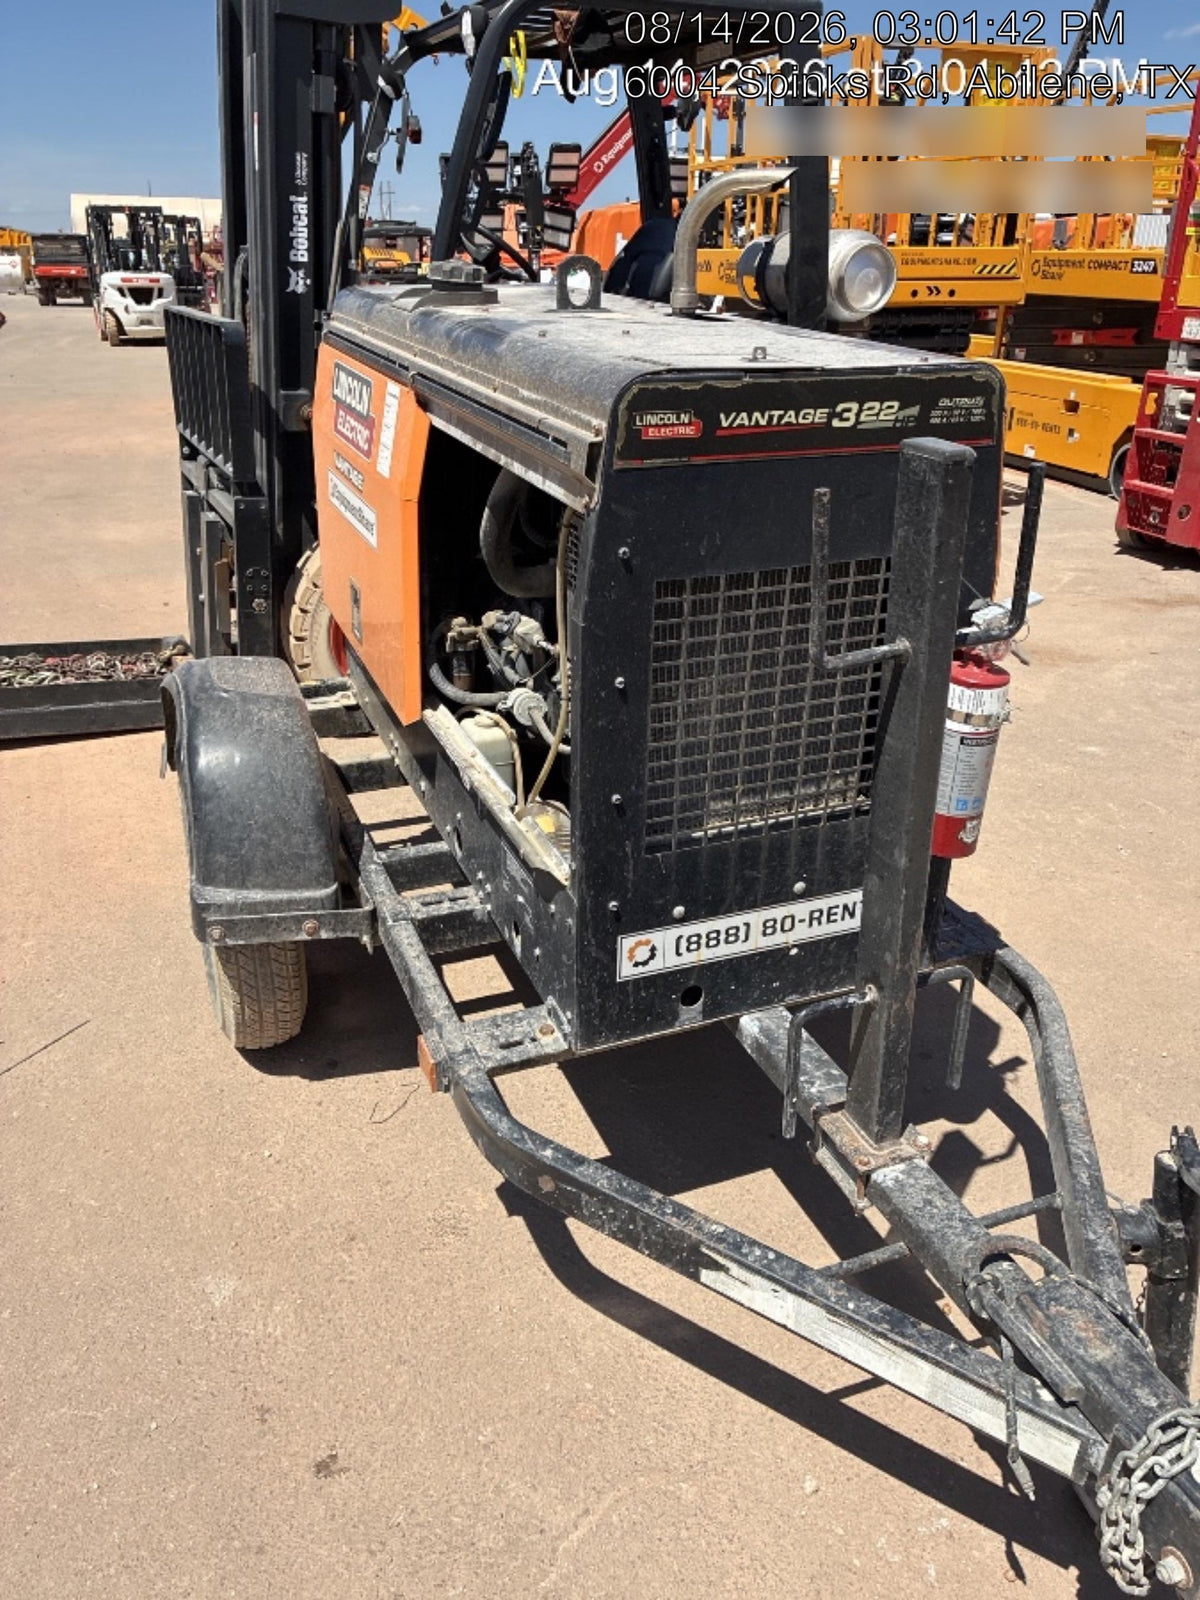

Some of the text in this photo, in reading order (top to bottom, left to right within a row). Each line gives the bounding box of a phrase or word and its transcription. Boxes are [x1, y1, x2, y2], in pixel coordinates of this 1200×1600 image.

[289, 194, 309, 262] Bobcat
[1088, 259, 1130, 271] COMPACT
[333, 367, 371, 417] LINCOLN
[635, 412, 690, 426] LINCOLN
[719, 408, 829, 428] VANTAGE
[831, 401, 900, 428] 322
[648, 426, 697, 437] ELECTRIC
[674, 901, 863, 957] (888) 80-REN
